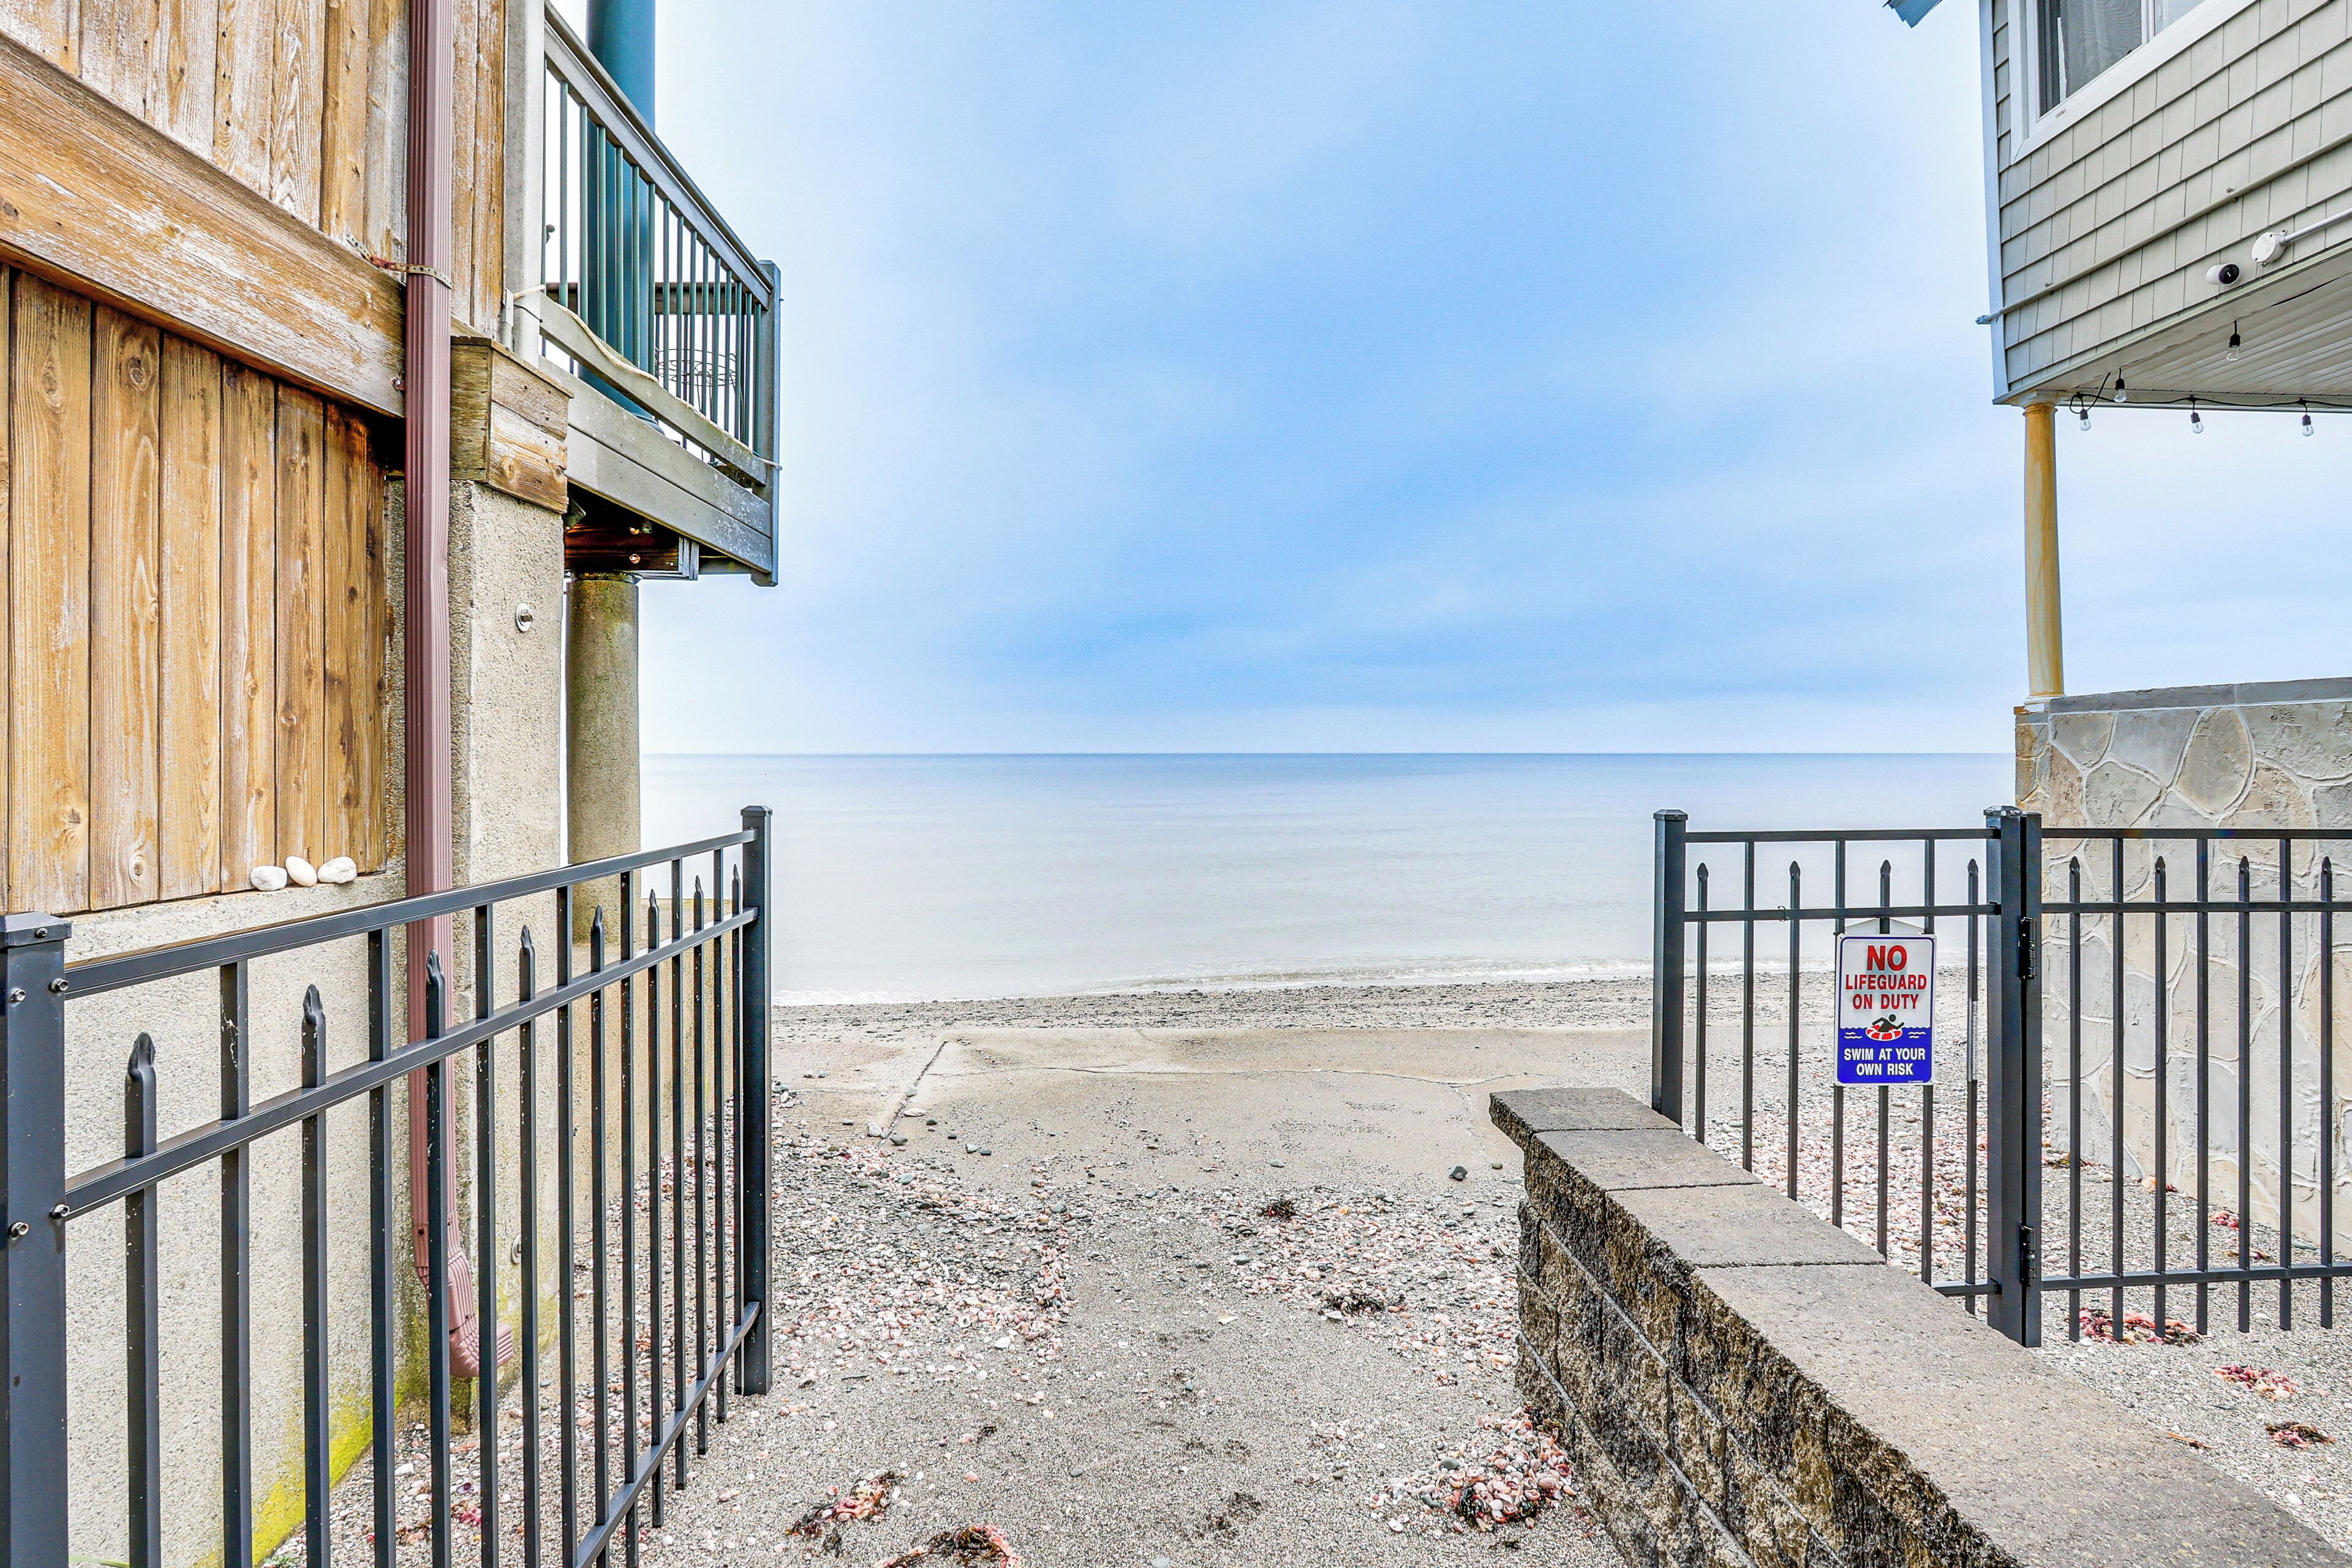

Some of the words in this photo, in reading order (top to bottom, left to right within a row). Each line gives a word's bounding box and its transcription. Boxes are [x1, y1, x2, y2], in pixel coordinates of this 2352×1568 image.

[1867, 945, 1907, 971] NO
[1845, 974, 1927, 990] LIFEGUARD
[1852, 993, 1872, 1009] ON
[1880, 993, 1919, 1009] DUTY
[1844, 1048, 1874, 1061] SWIM
[1879, 1048, 1893, 1060] AT
[1895, 1048, 1926, 1060] YOUR
[1856, 1063, 1882, 1076] OWN
[1887, 1063, 1913, 1076] RISK
